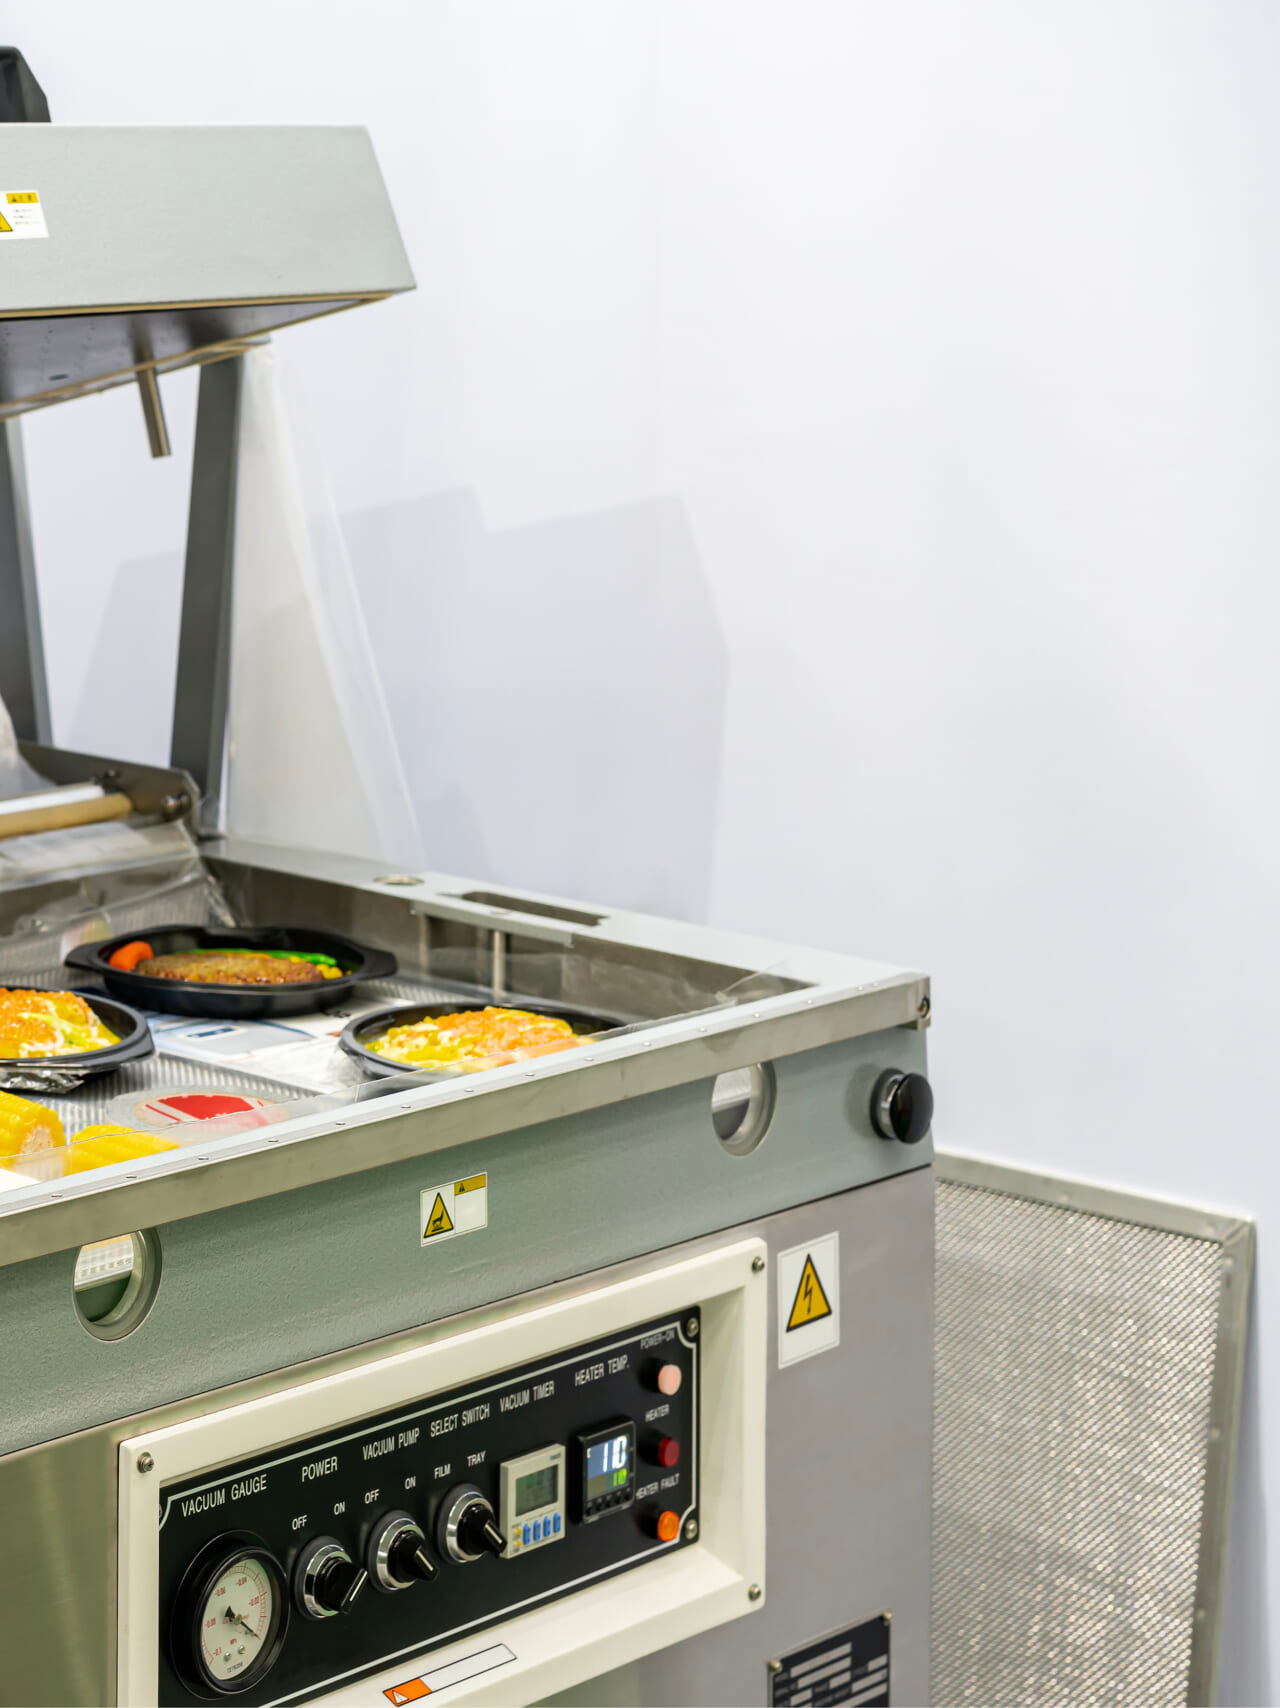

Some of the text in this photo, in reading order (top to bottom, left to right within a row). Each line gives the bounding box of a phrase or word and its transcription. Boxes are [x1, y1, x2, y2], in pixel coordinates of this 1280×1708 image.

[640, 1329, 675, 1350] POWER-ON
[575, 1354, 630, 1387] HEATER TEMP.
[499, 1382, 555, 1413] VACUUM TIMER
[430, 1403, 490, 1438] SELECT SWITCH
[645, 1404, 670, 1423] HEATER
[362, 1427, 420, 1461] VACUUM PUMP
[467, 1450, 486, 1468] TRAY
[301, 1456, 338, 1483] POWER
[434, 1463, 451, 1480] FILM
[404, 1476, 417, 1490] ON
[661, 1472, 680, 1490] FAULT
[181, 1474, 267, 1518] VACUUM GAUGE
[364, 1488, 380, 1505] OFF
[333, 1501, 346, 1516] ON
[292, 1515, 308, 1530] OFF
